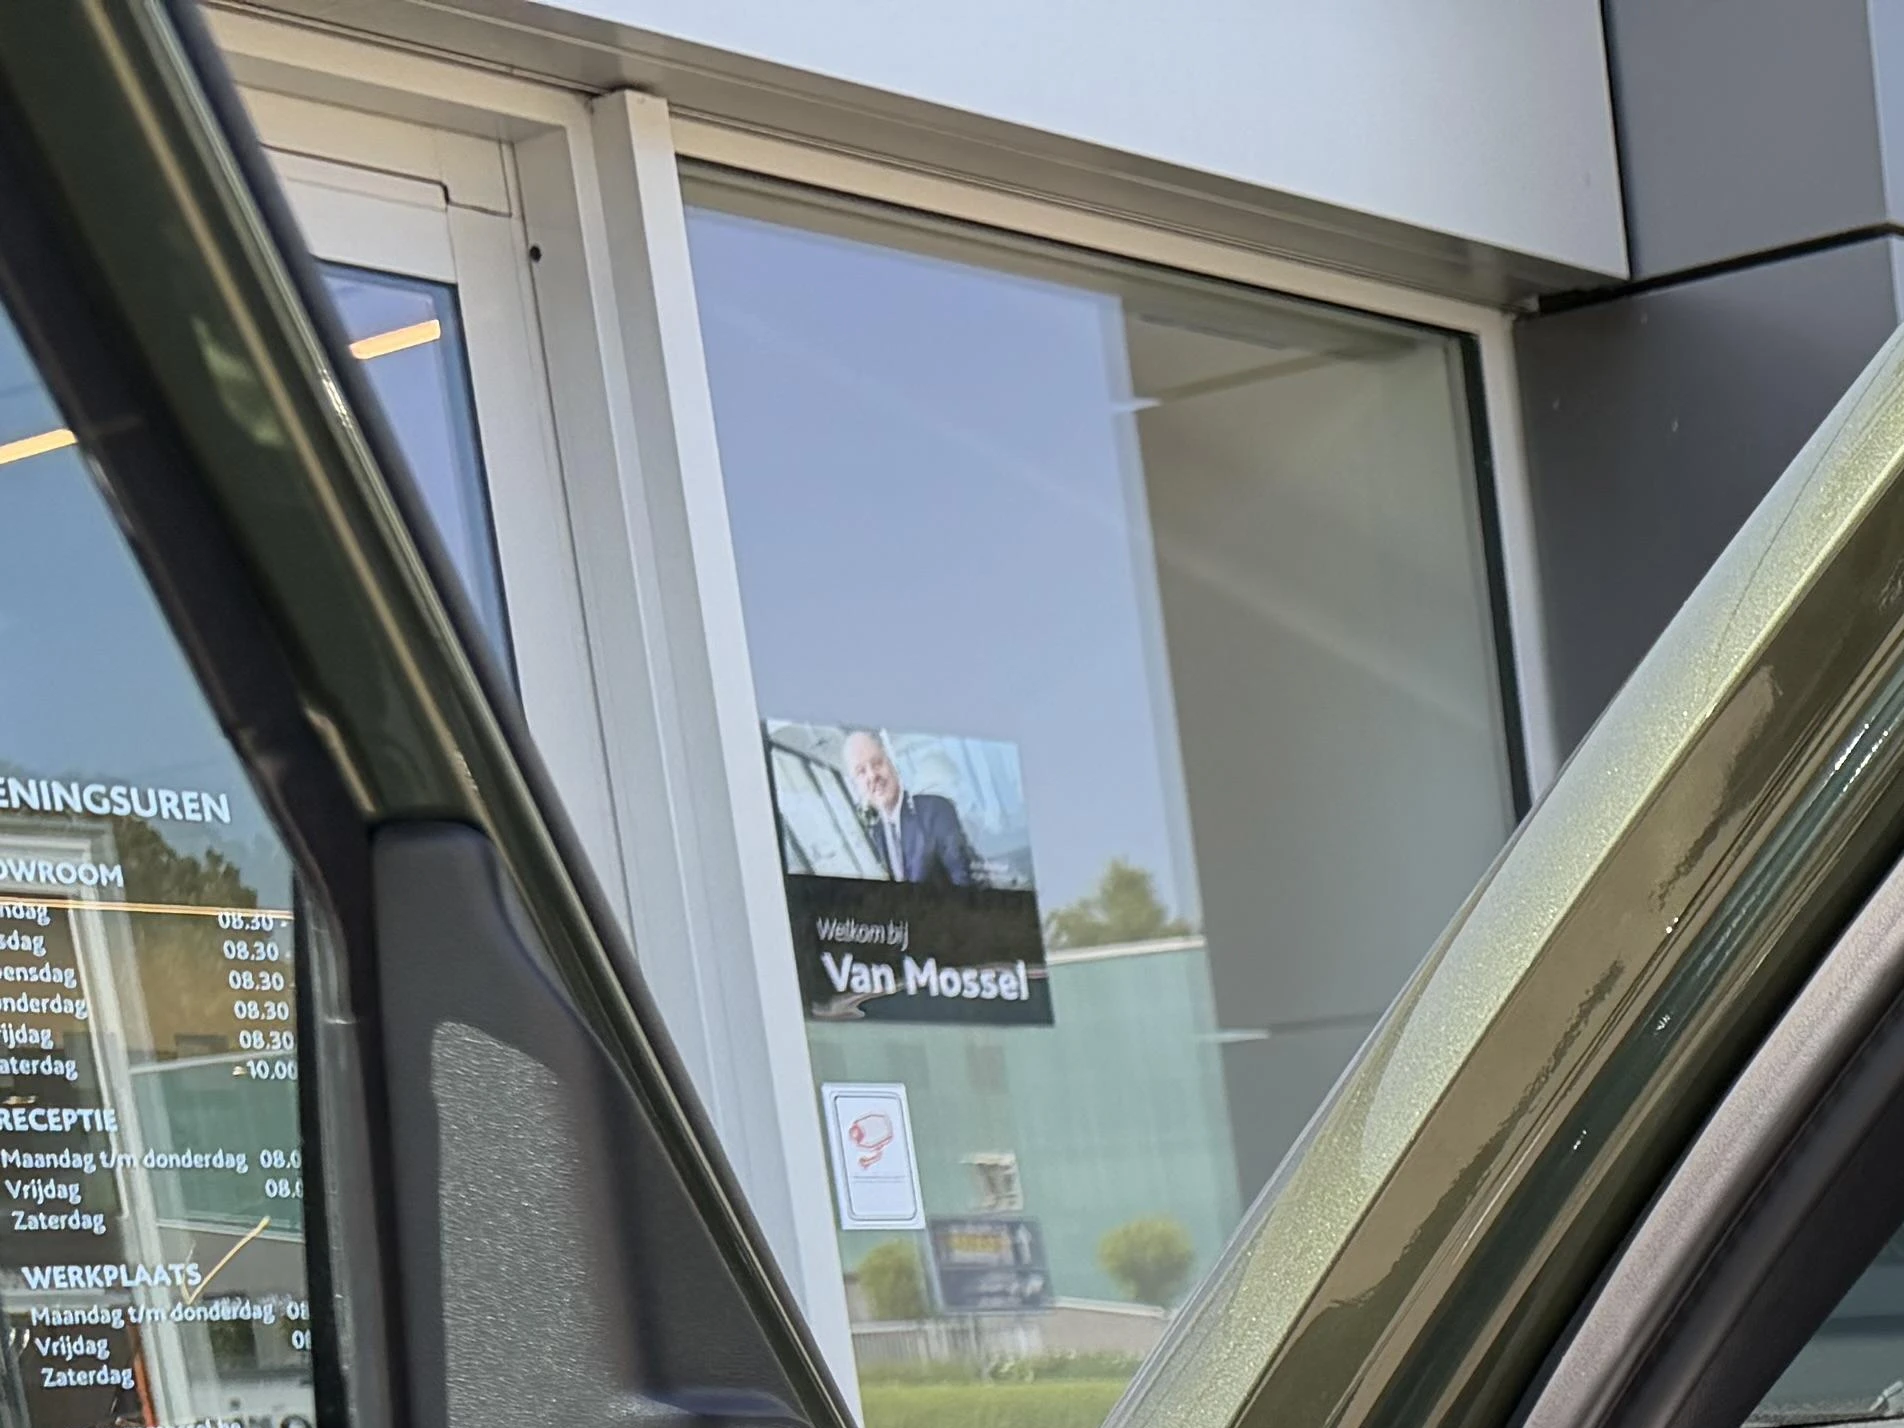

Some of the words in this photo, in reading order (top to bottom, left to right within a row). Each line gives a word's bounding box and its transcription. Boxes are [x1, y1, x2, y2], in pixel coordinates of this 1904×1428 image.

[816, 916, 885, 944] Welkom
[887, 918, 909, 951] bij
[223, 940, 279, 961] 08.30
[228, 970, 284, 991] 08.30
[820, 951, 896, 994] Van
[903, 955, 1029, 1000] Mossel
[234, 1000, 289, 1020] 08.30
[239, 1029, 294, 1050] 08.30
[0, 1107, 118, 1132] RECEPTIE
[1, 1148, 96, 1174] Maandag
[143, 1148, 249, 1174] donderdag
[5, 1178, 81, 1204] Vrijdag
[12, 1208, 106, 1235] Zaterdag
[21, 1263, 202, 1290] WERKPLAATS
[31, 1304, 125, 1328] Maandag
[170, 1301, 275, 1325] donderdag
[35, 1334, 111, 1361] Vrijdag
[41, 1364, 135, 1389] Zaterdag
